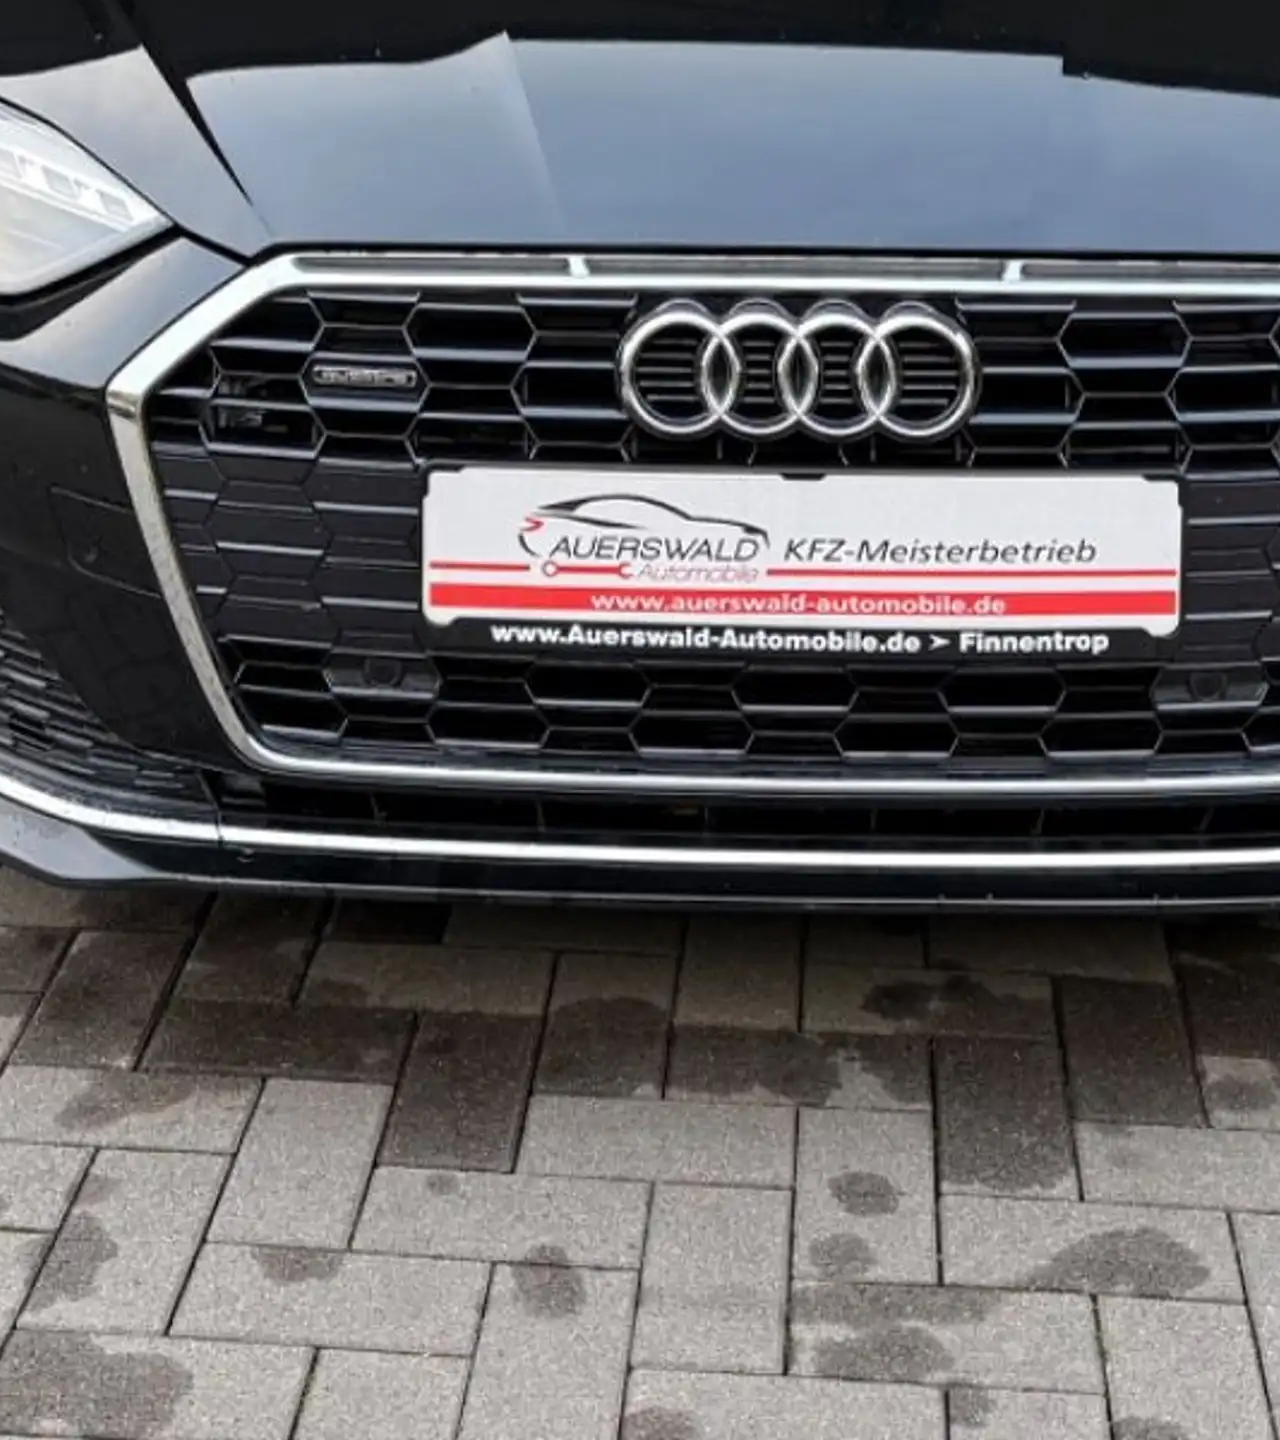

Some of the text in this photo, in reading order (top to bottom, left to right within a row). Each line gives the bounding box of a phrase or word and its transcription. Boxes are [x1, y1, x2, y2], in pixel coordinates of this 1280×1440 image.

[548, 536, 1097, 564] AUERSWALD KFZ-Meisterbetrieb
[636, 562, 759, 584] Automobile
[590, 592, 1007, 615] www.auerswald-automobile.de
[490, 624, 921, 654] www.Auerswald-Automobile.de
[959, 631, 1110, 655] Finnentrop
